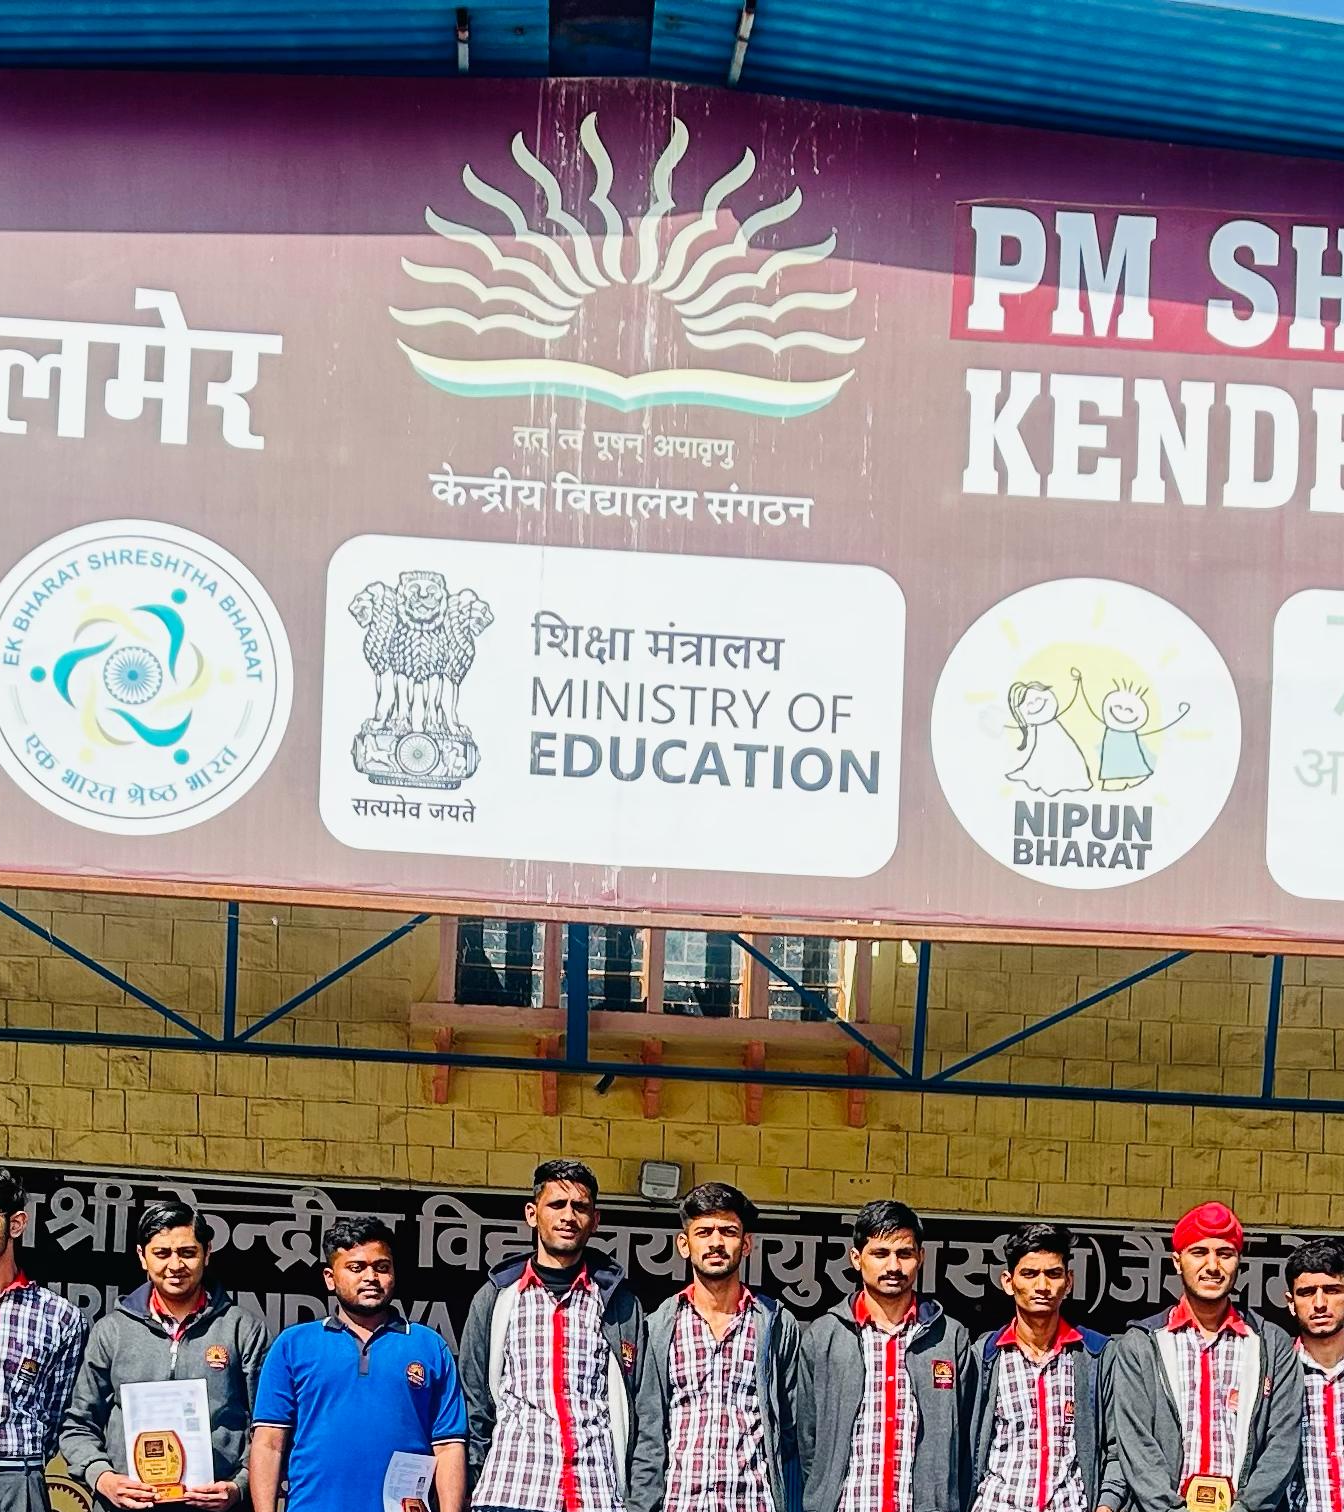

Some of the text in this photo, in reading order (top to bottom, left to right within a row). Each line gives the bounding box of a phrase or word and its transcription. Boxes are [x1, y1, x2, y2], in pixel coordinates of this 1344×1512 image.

[966, 206, 1157, 340] PM
[428, 462, 816, 528] केन्द्रीय विद्यालय संगठन
[3, 549, 263, 684] EK BHARAT SHRESHTHA BHARAT
[530, 610, 786, 672] शिक्षा मंत्रालय
[530, 675, 854, 735] MINISTRY OF
[24, 732, 58, 771] एक
[61, 768, 118, 805] भारत
[184, 744, 240, 793] भारत
[529, 730, 881, 795] EDUCATION
[351, 795, 477, 824] सत्यमेव जयते
[1014, 800, 1153, 842] NIPUN
[1013, 837, 1153, 871] BHARAT
